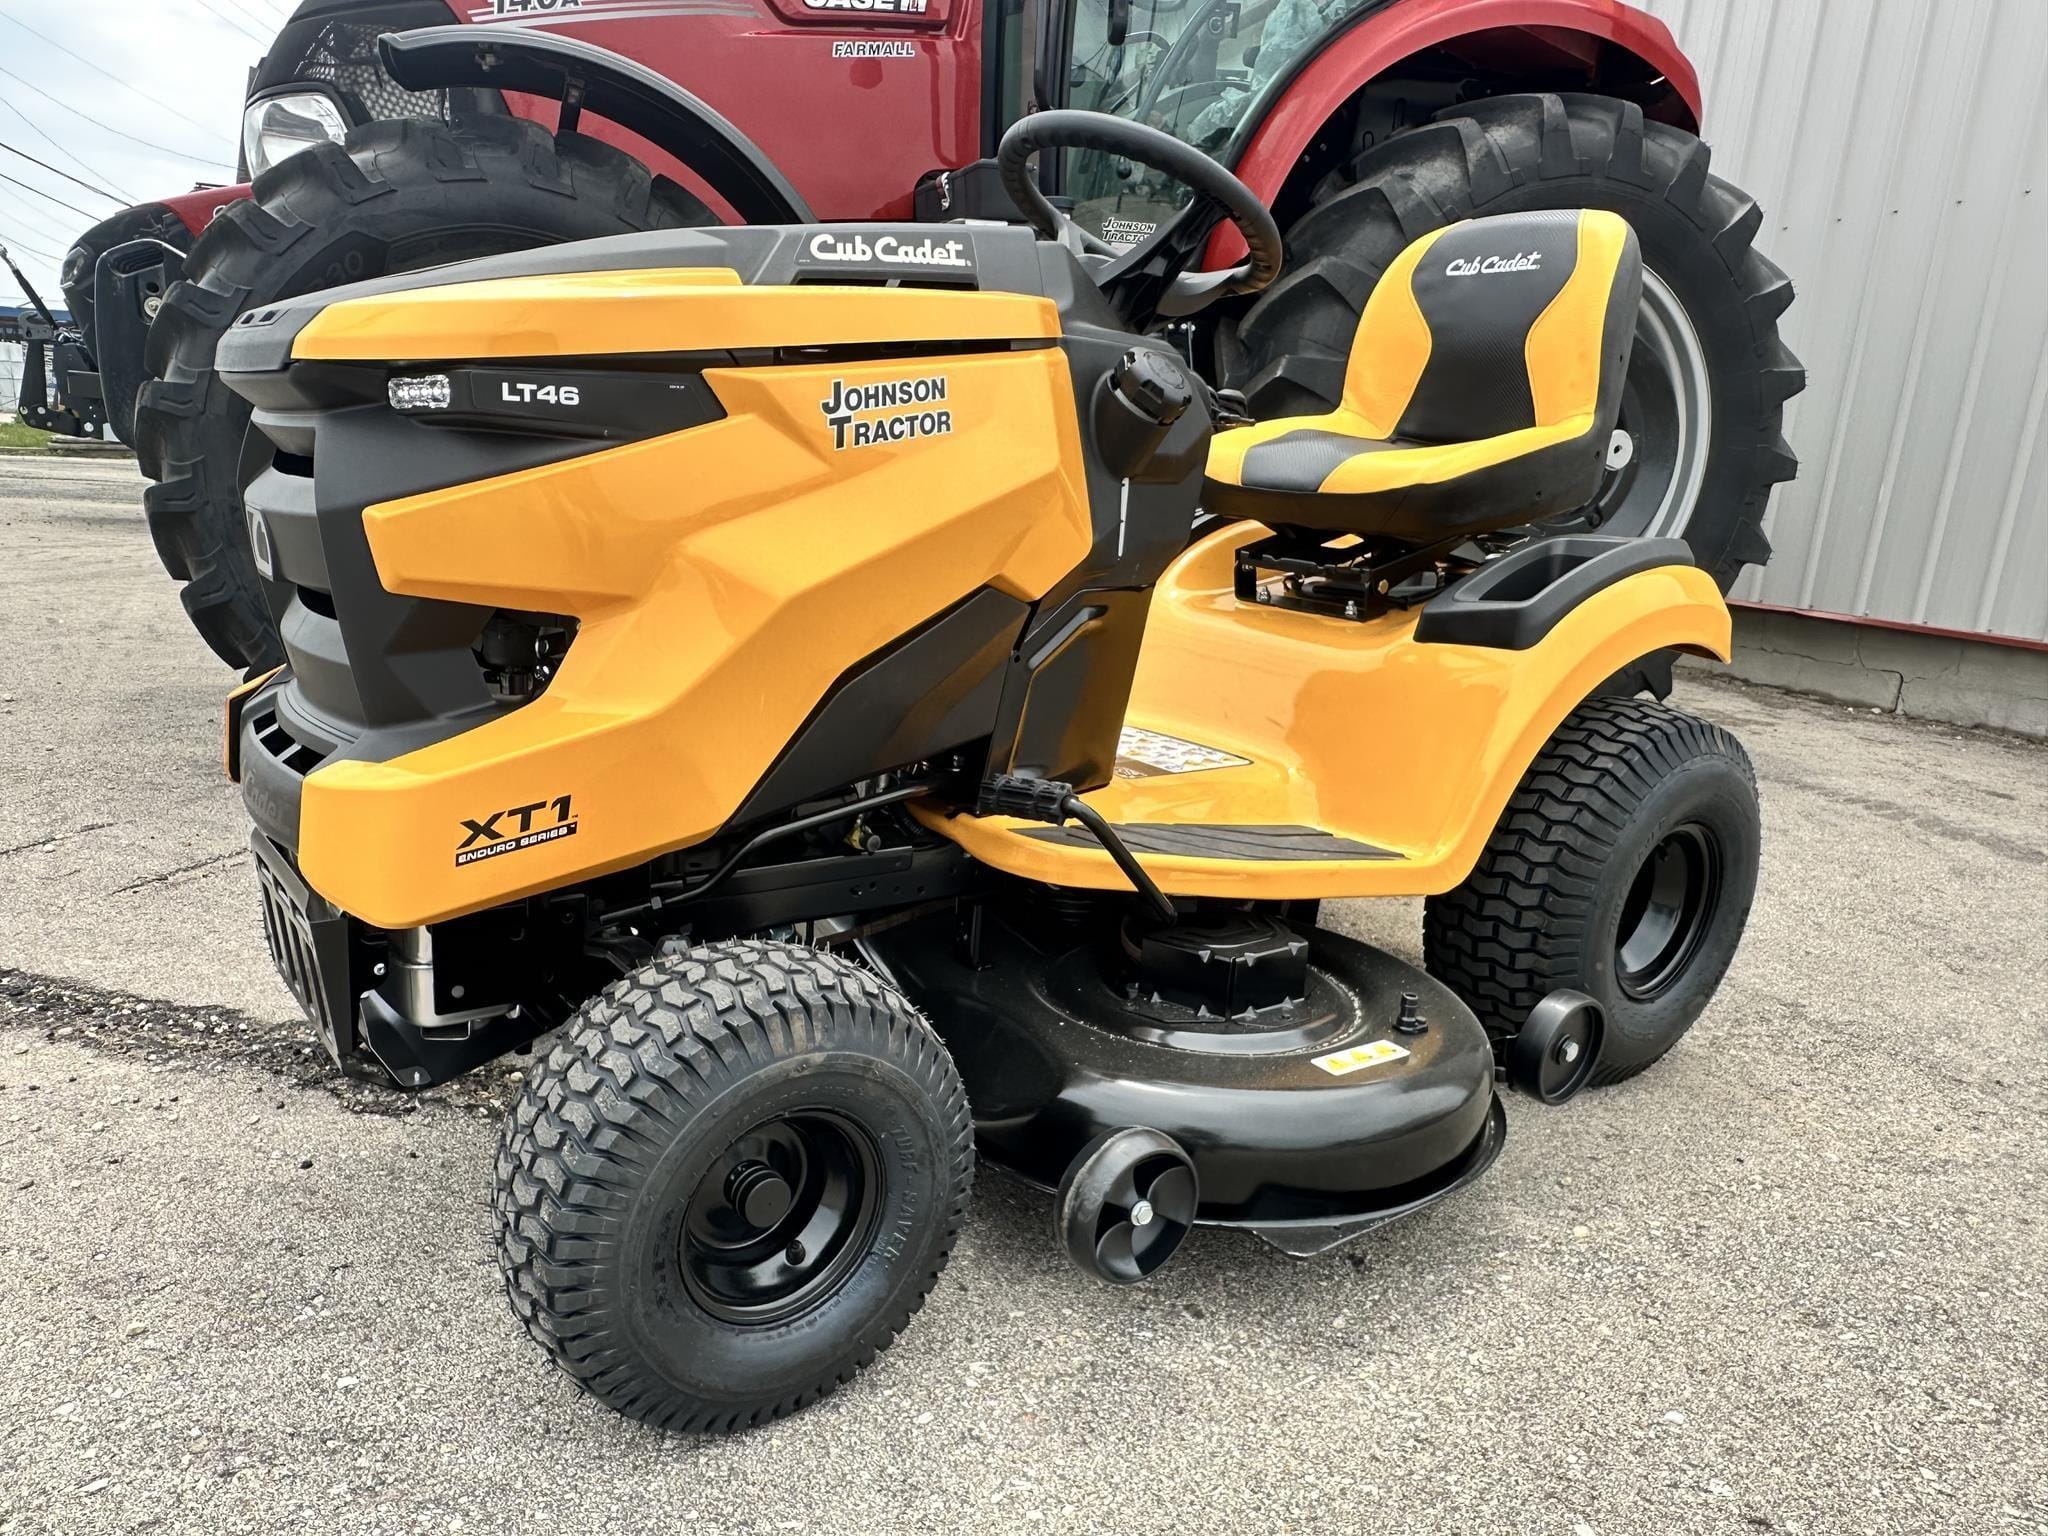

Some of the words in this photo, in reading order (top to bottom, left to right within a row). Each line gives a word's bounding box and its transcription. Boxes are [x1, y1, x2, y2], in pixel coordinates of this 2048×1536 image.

[832, 42, 915, 57] FARMALL
[1102, 217, 1157, 233] JOHNSON
[1102, 230, 1149, 243] TRACTO
[810, 234, 873, 262] Cub
[874, 236, 966, 266] Cadet
[1446, 256, 1481, 276] Cub
[1481, 251, 1541, 273] Cadet
[502, 382, 580, 406] LT46
[821, 377, 946, 415] JOHNSON
[828, 410, 951, 450] TRACTOR
[456, 794, 572, 850] XT1
[458, 840, 516, 863] ENDURO
[520, 826, 568, 847] SERIES
